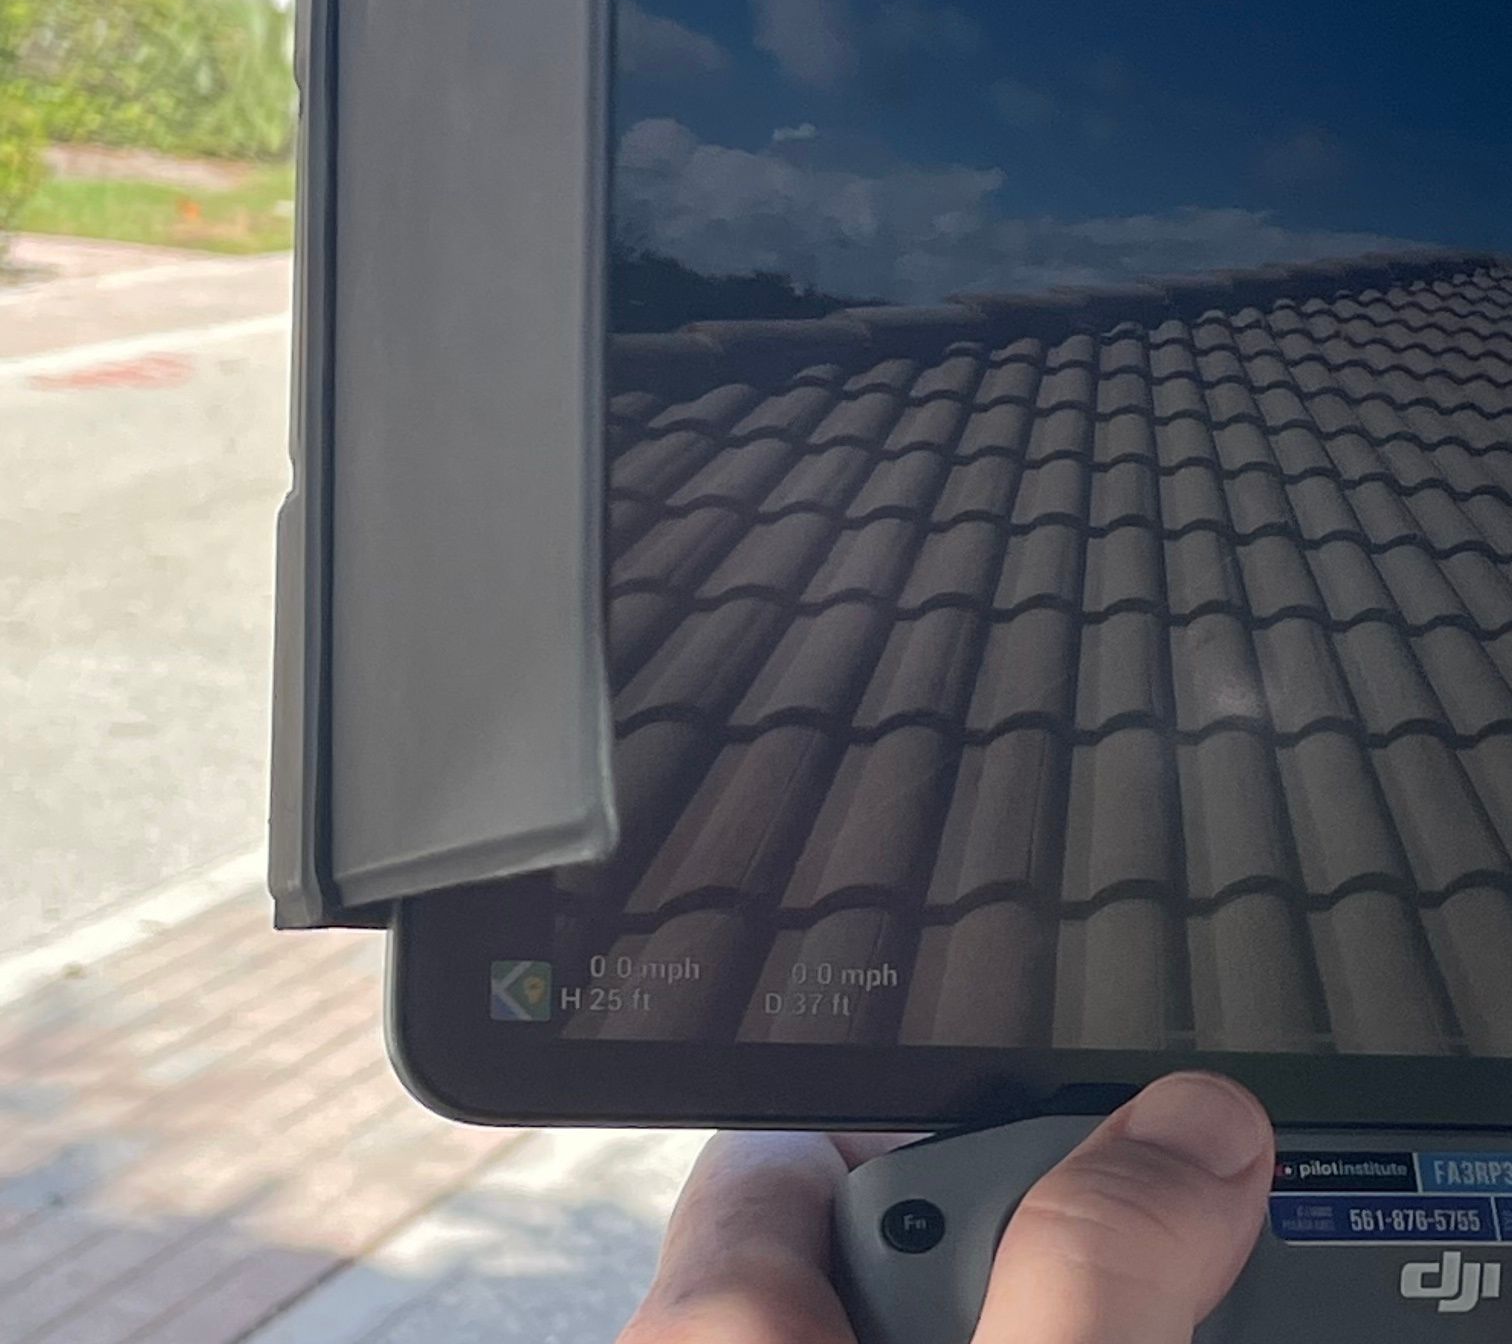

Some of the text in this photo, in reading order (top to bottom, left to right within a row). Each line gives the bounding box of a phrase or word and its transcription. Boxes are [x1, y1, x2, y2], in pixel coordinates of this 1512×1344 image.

[640, 956, 700, 984] mph
[841, 963, 898, 992] mph
[560, 987, 652, 1011] H 25 ft
[764, 992, 851, 1016] D 37 ft
[1349, 1209, 1481, 1233] 561-876-5755
